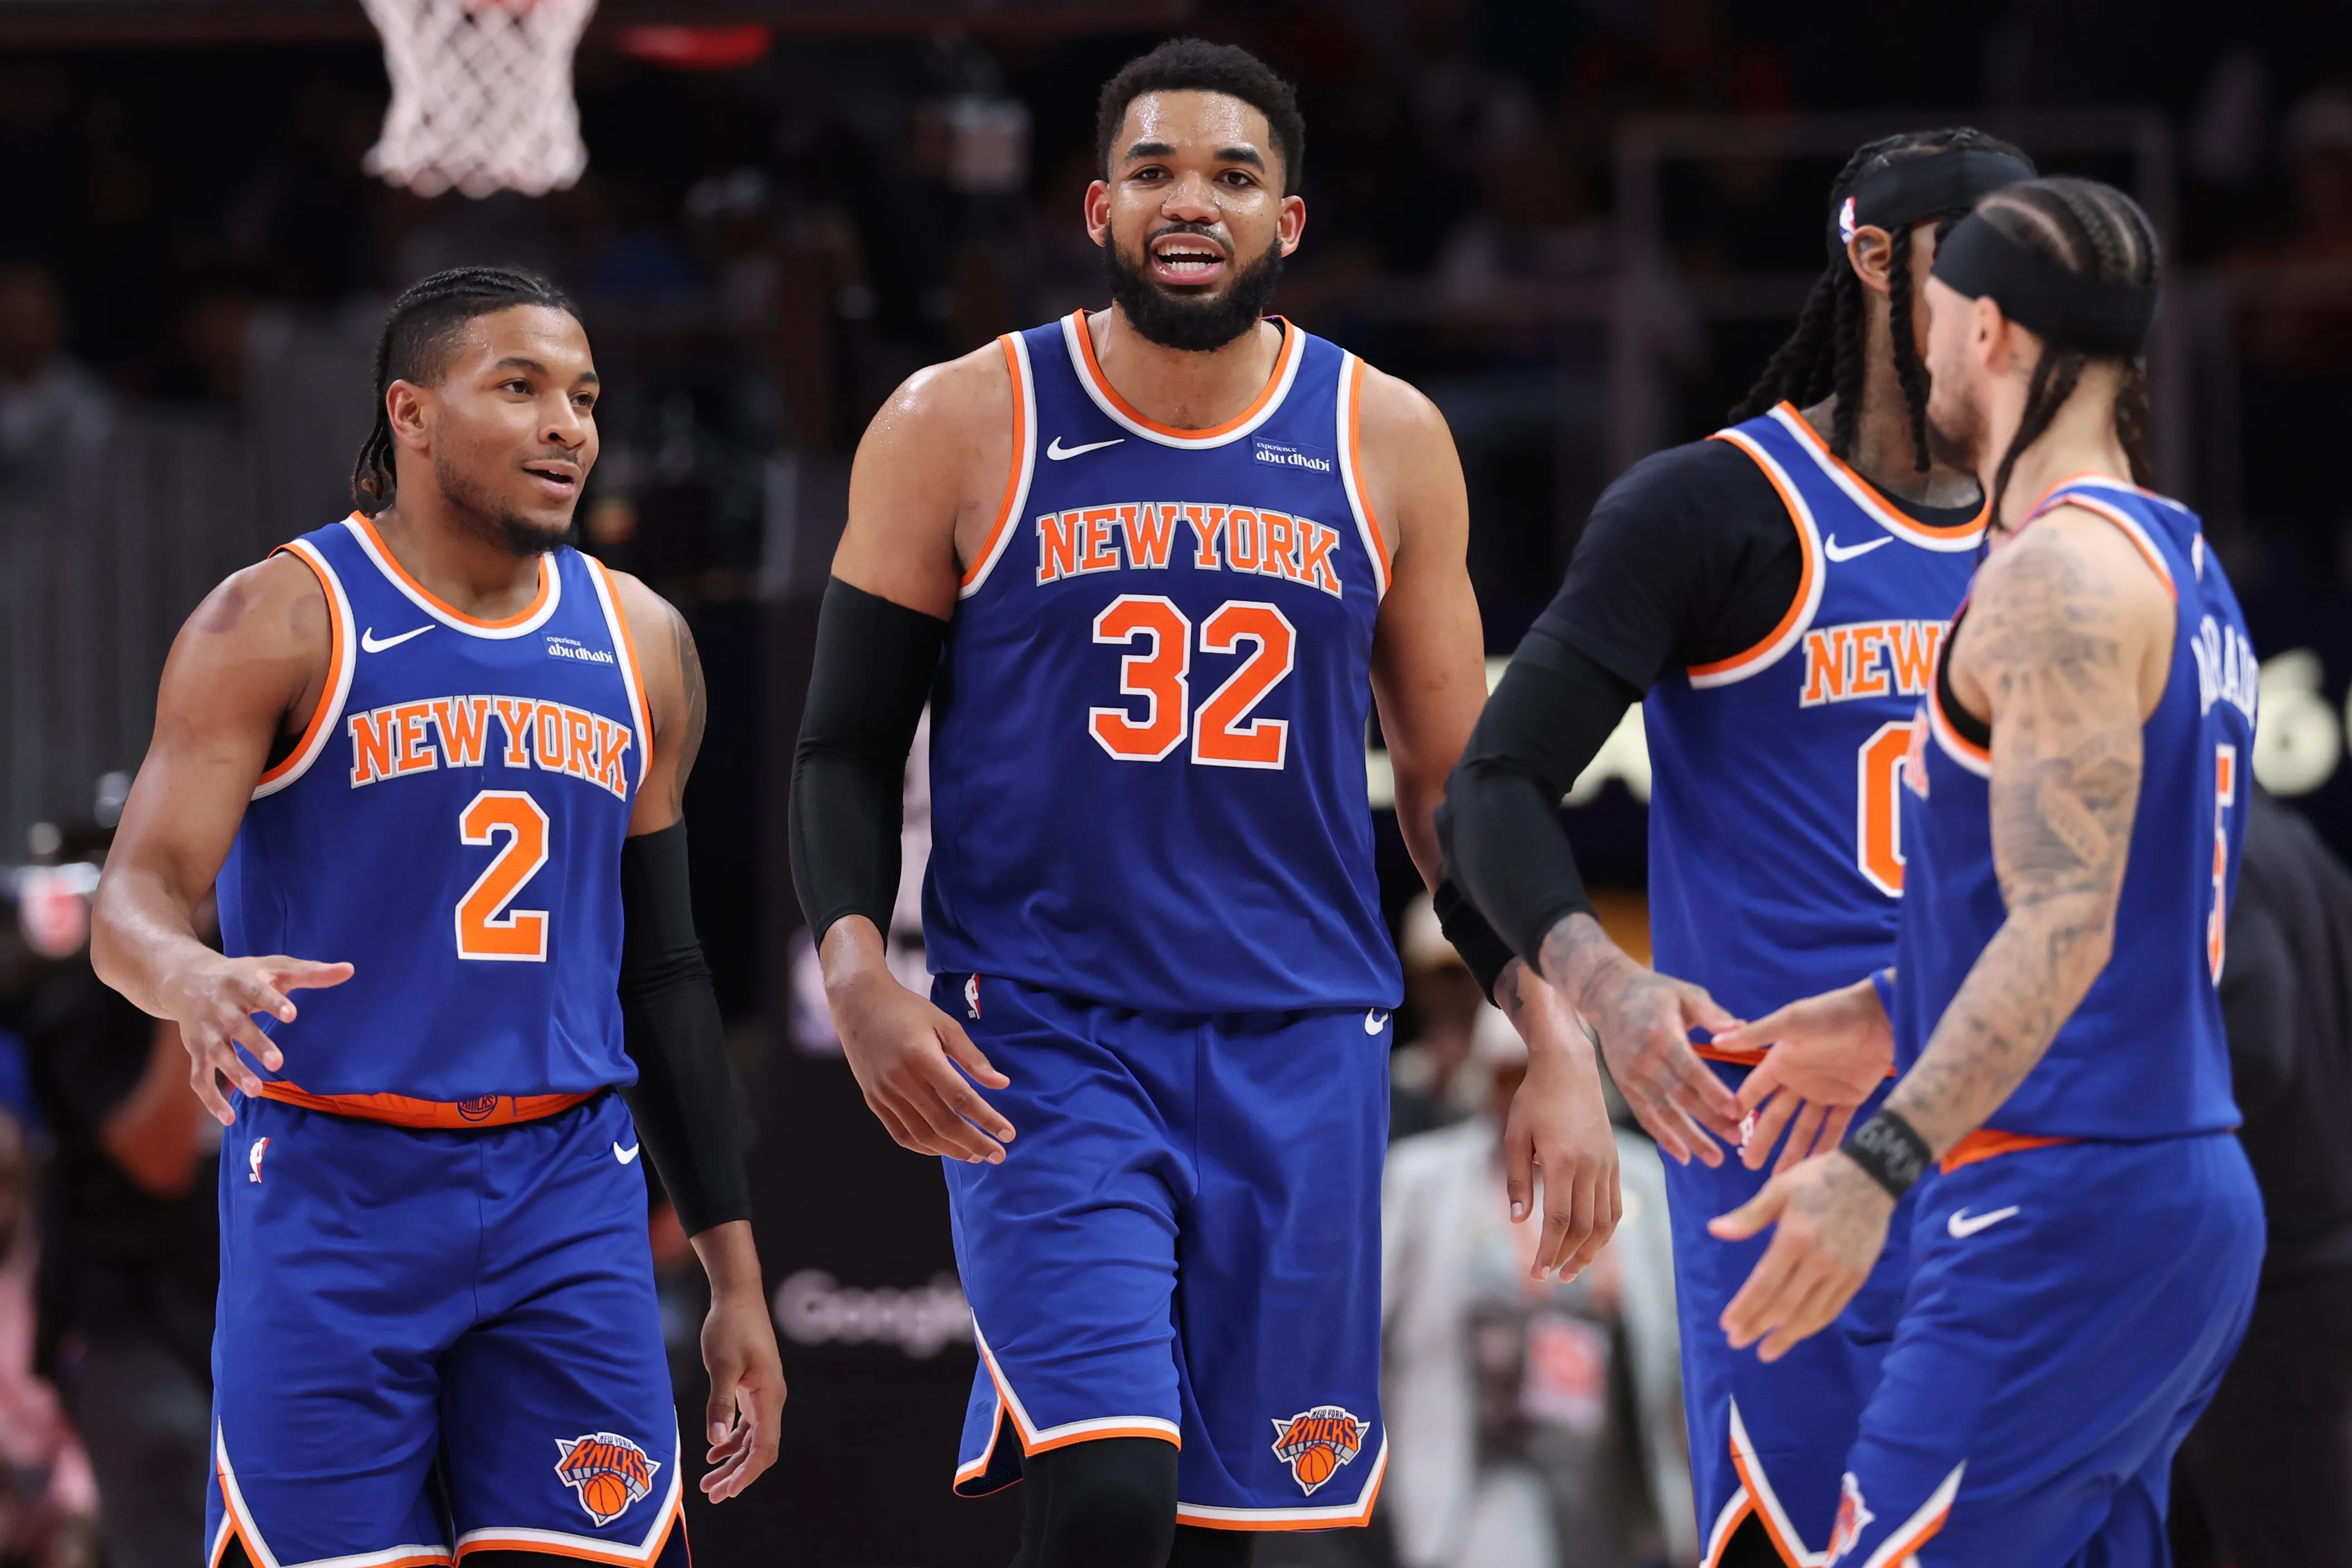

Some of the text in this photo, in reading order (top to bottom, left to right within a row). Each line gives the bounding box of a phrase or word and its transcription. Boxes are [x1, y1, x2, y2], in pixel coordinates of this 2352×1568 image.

[1256, 450, 1330, 472] abu dhabi
[1257, 442, 1297, 453] experience
[1036, 502, 1342, 599] NEW YORK
[546, 636, 581, 647] experience
[548, 643, 613, 663] abu dhabi
[1089, 594, 1297, 770] 32
[347, 695, 632, 802] NEW YORK
[455, 790, 550, 963] 2
[1311, 1408, 1344, 1420] NEW YORK
[598, 1435, 632, 1450] NEW YORK
[1276, 1416, 1359, 1452] KNICKS
[560, 1438, 649, 1490] KNICKS
